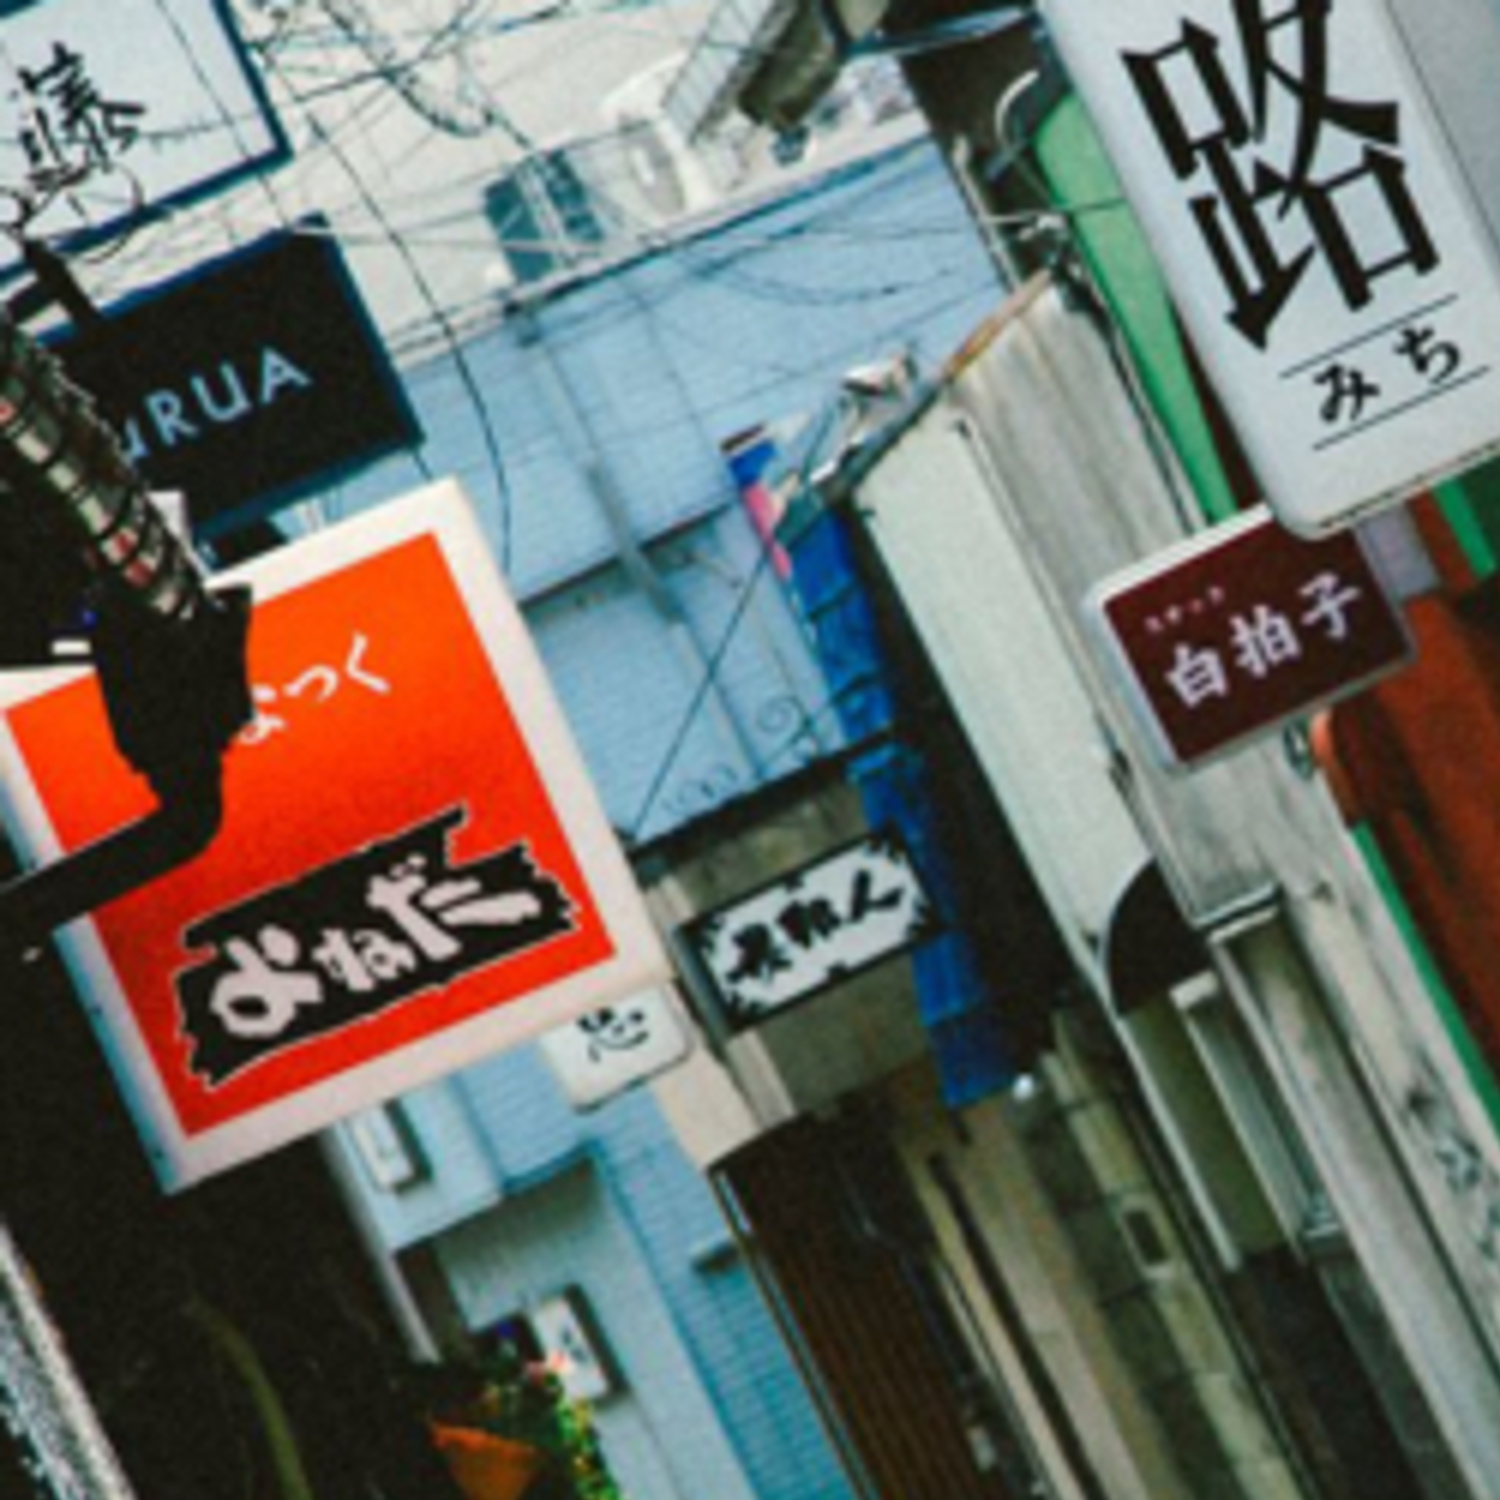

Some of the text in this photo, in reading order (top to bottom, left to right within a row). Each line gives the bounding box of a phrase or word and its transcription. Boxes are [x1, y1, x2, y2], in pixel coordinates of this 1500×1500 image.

[1121, 0, 1440, 351] 路
[1311, 325, 1462, 423] みち
[1164, 572, 1362, 709] 白拍子
